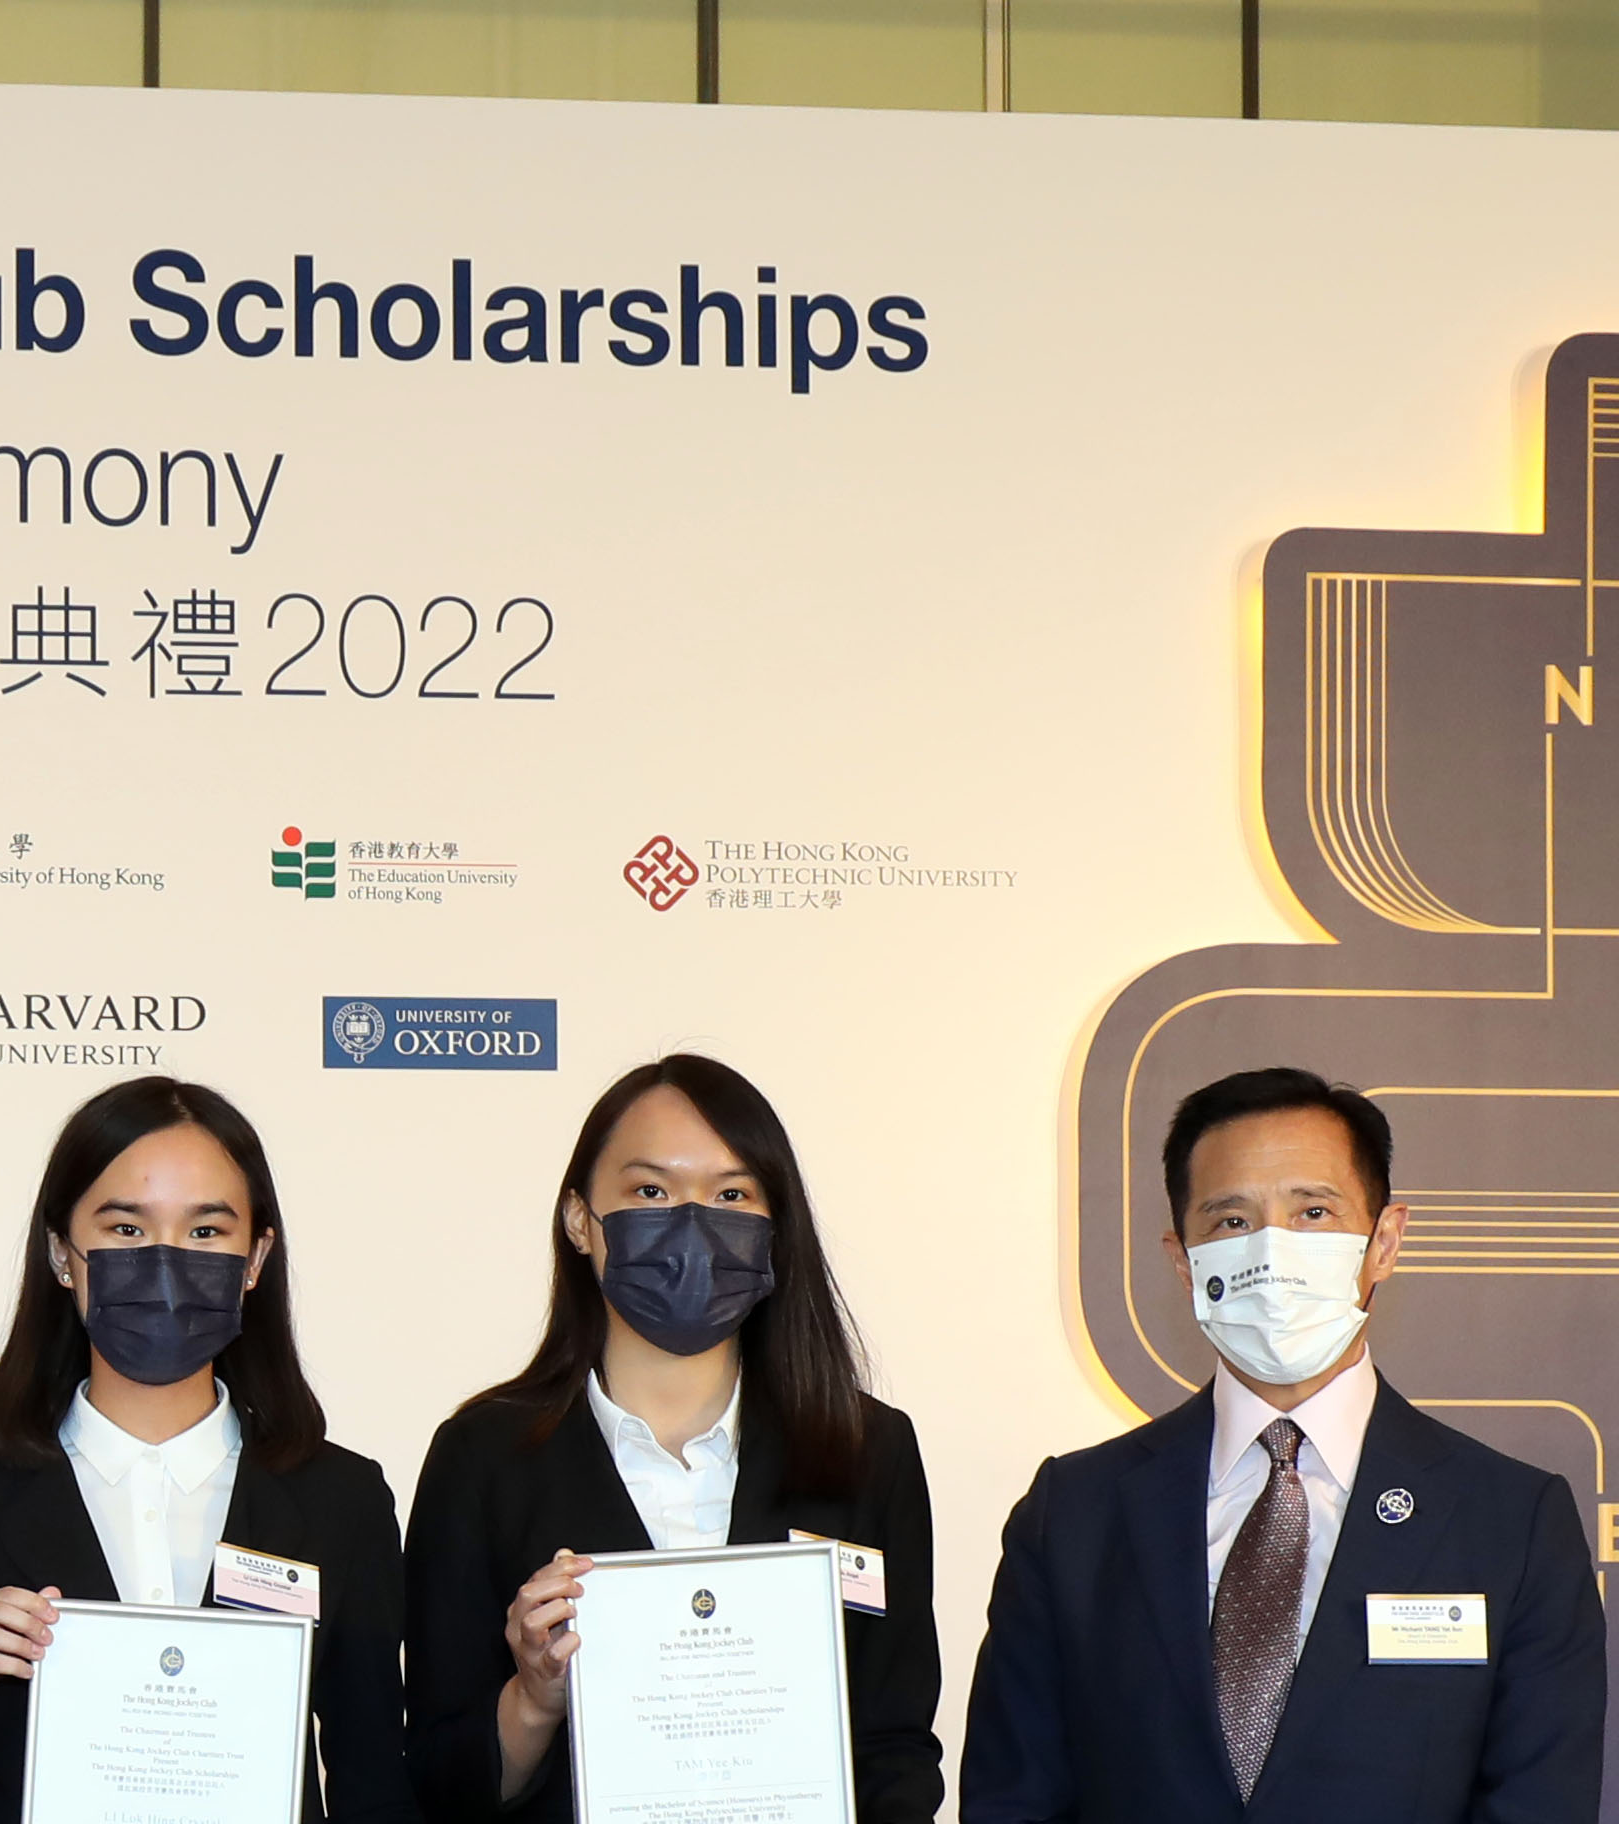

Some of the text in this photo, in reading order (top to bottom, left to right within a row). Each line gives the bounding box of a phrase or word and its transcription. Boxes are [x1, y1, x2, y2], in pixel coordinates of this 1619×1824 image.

[129, 248, 929, 395] Scholarships
[349, 841, 459, 860] 香港教育大學
[35, 866, 55, 885] of
[58, 866, 112, 891] Hong
[114, 867, 165, 892] Kong
[347, 868, 518, 888] The Education University
[347, 885, 443, 905] of Hong Kong
[705, 887, 843, 911] 香港理工大學
[395, 1009, 512, 1024] UNIVERSITY OF
[394, 1029, 541, 1056] OXFORD
